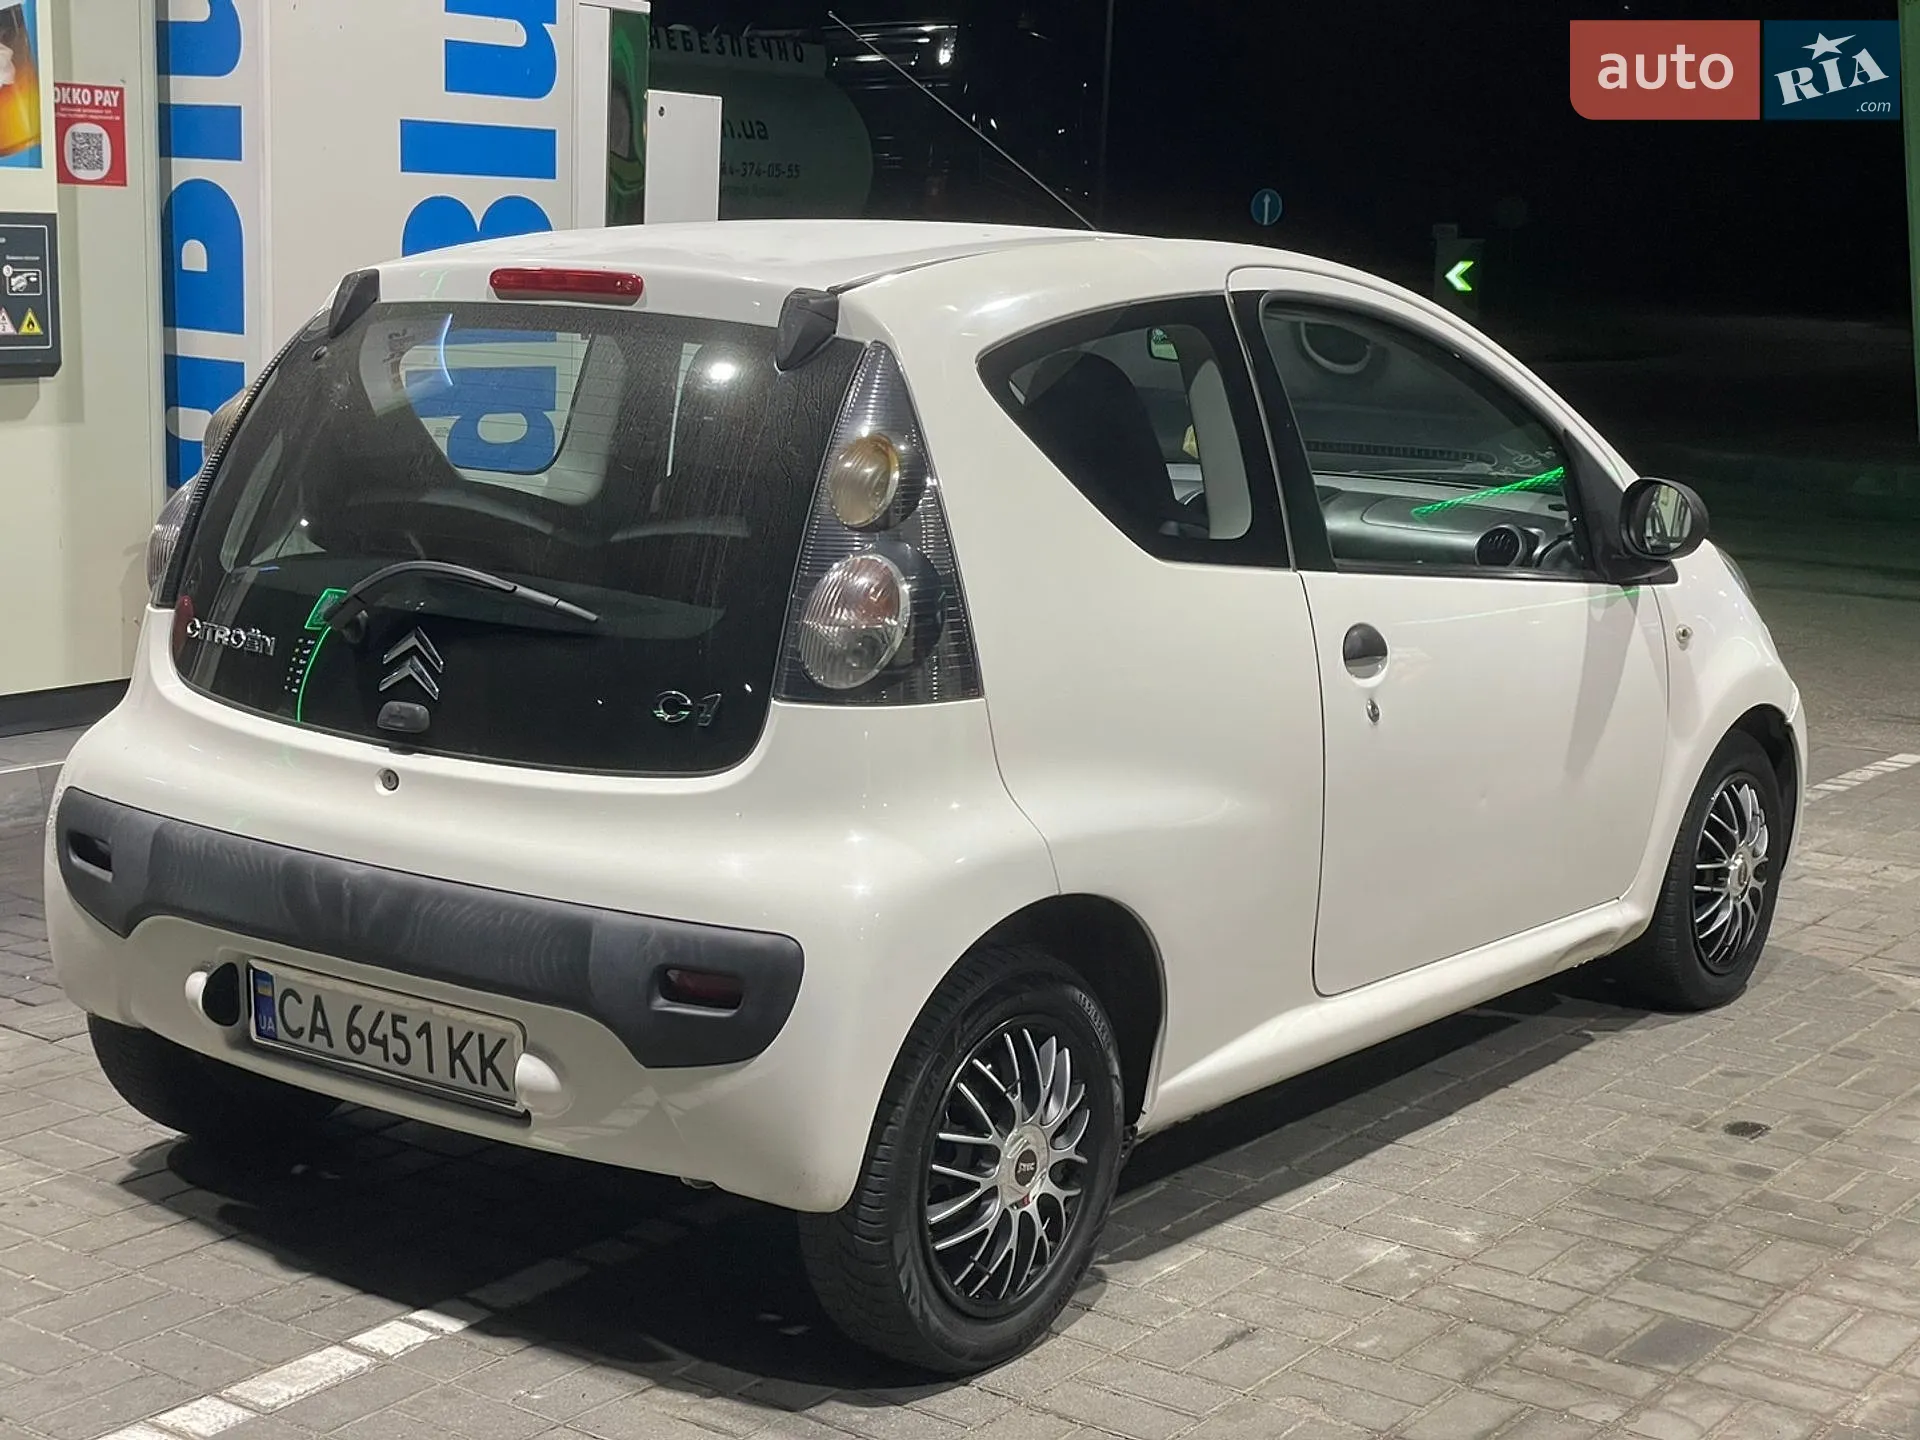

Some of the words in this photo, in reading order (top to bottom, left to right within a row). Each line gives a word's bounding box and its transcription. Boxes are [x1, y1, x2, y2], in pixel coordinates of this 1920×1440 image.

[94, 89, 120, 107] PAY
[653, 690, 722, 727] C1
[259, 1015, 276, 1034] UA
[278, 988, 335, 1049] CA
[346, 1004, 435, 1075] 6451
[447, 1026, 510, 1092] KK
